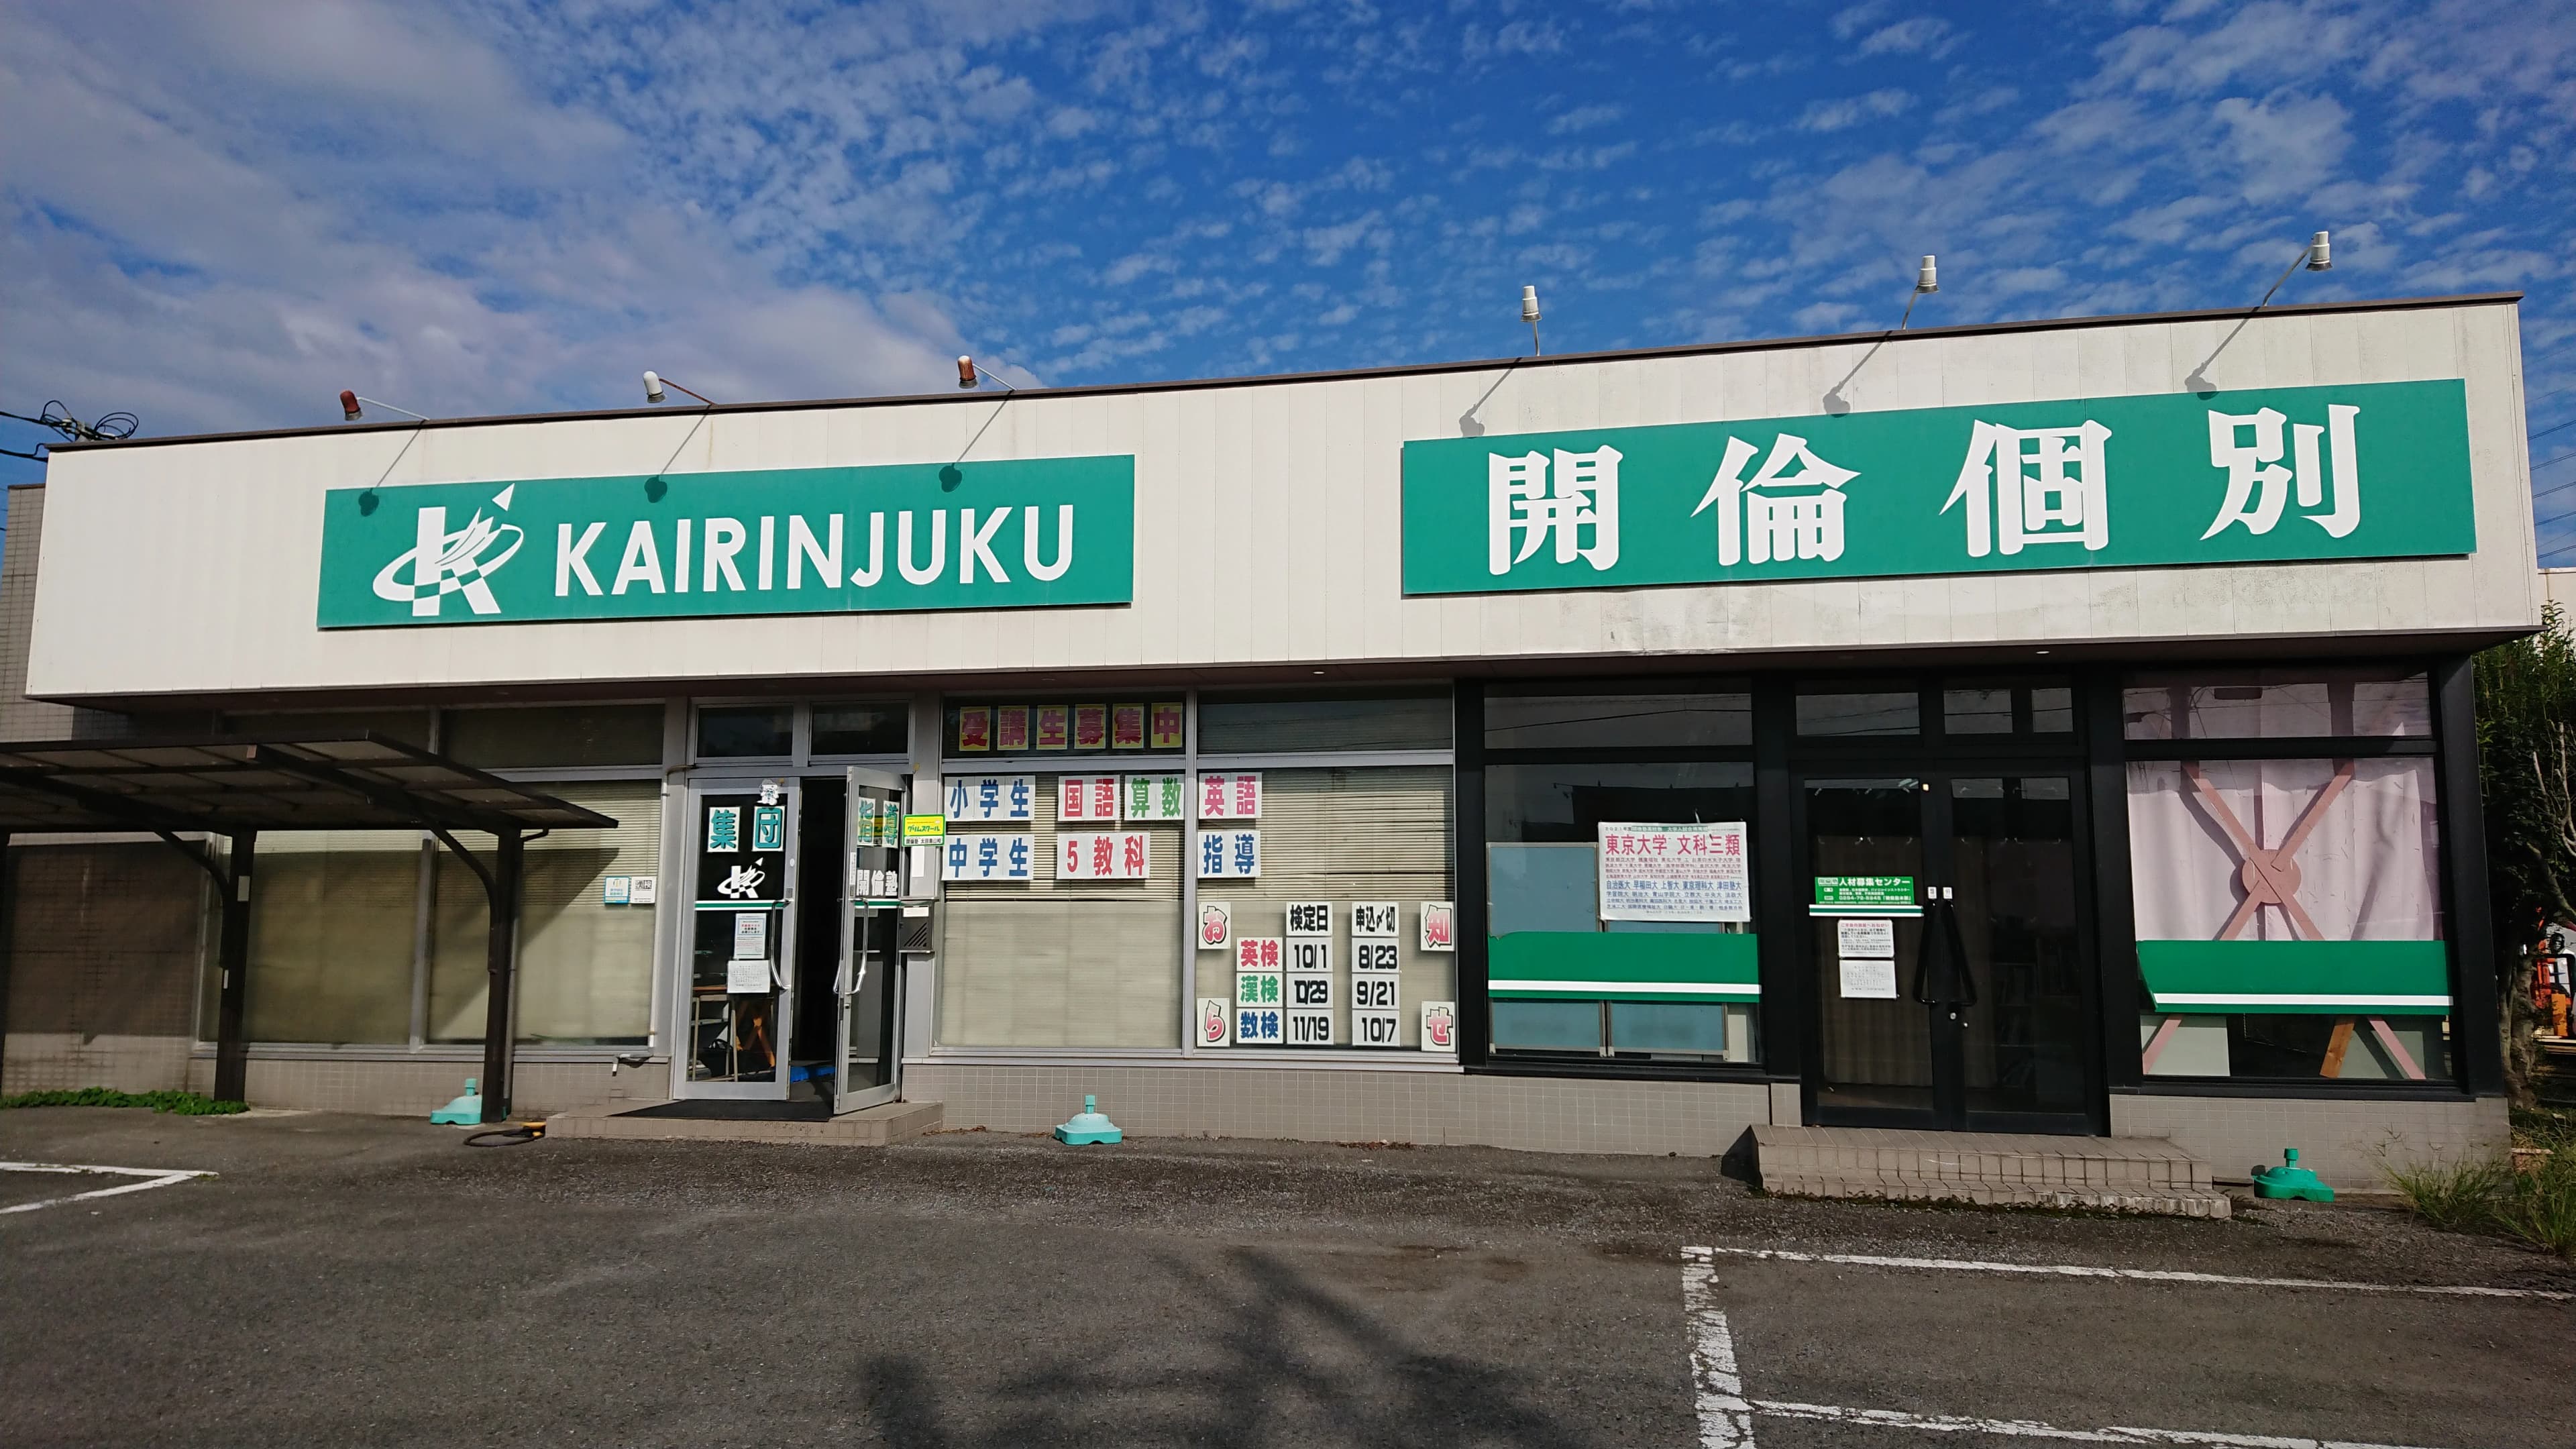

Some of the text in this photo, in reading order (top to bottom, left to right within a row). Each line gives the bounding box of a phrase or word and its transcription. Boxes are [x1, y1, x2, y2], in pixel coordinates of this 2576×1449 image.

[1487, 403, 2361, 576] 開倫個別
[556, 504, 1073, 596] KAIRINJUKU
[961, 706, 1180, 747] 受講生募集中
[950, 778, 1028, 818] 小学生
[1065, 777, 1181, 818] 国語 算数
[1204, 775, 1256, 816] 英語
[710, 807, 784, 850] 集団
[1605, 834, 1740, 855] 東京大学 文科三類
[949, 837, 1028, 877] 中学生
[1067, 835, 1144, 875] 5教科
[1203, 834, 1254, 873] 指導
[857, 869, 898, 896] 開倫塾
[1203, 905, 1227, 945] お
[1291, 905, 1395, 932] 検定日 申込〆切
[1426, 904, 1452, 947] 知
[1240, 940, 1397, 970] 英検 10/1 8/23
[1240, 975, 1395, 1006] 漢検 10/29 9/21
[1205, 1000, 1225, 1042] ら
[1240, 1011, 1396, 1042] 数検 11/19 10/7
[1426, 1006, 1453, 1045] せ
